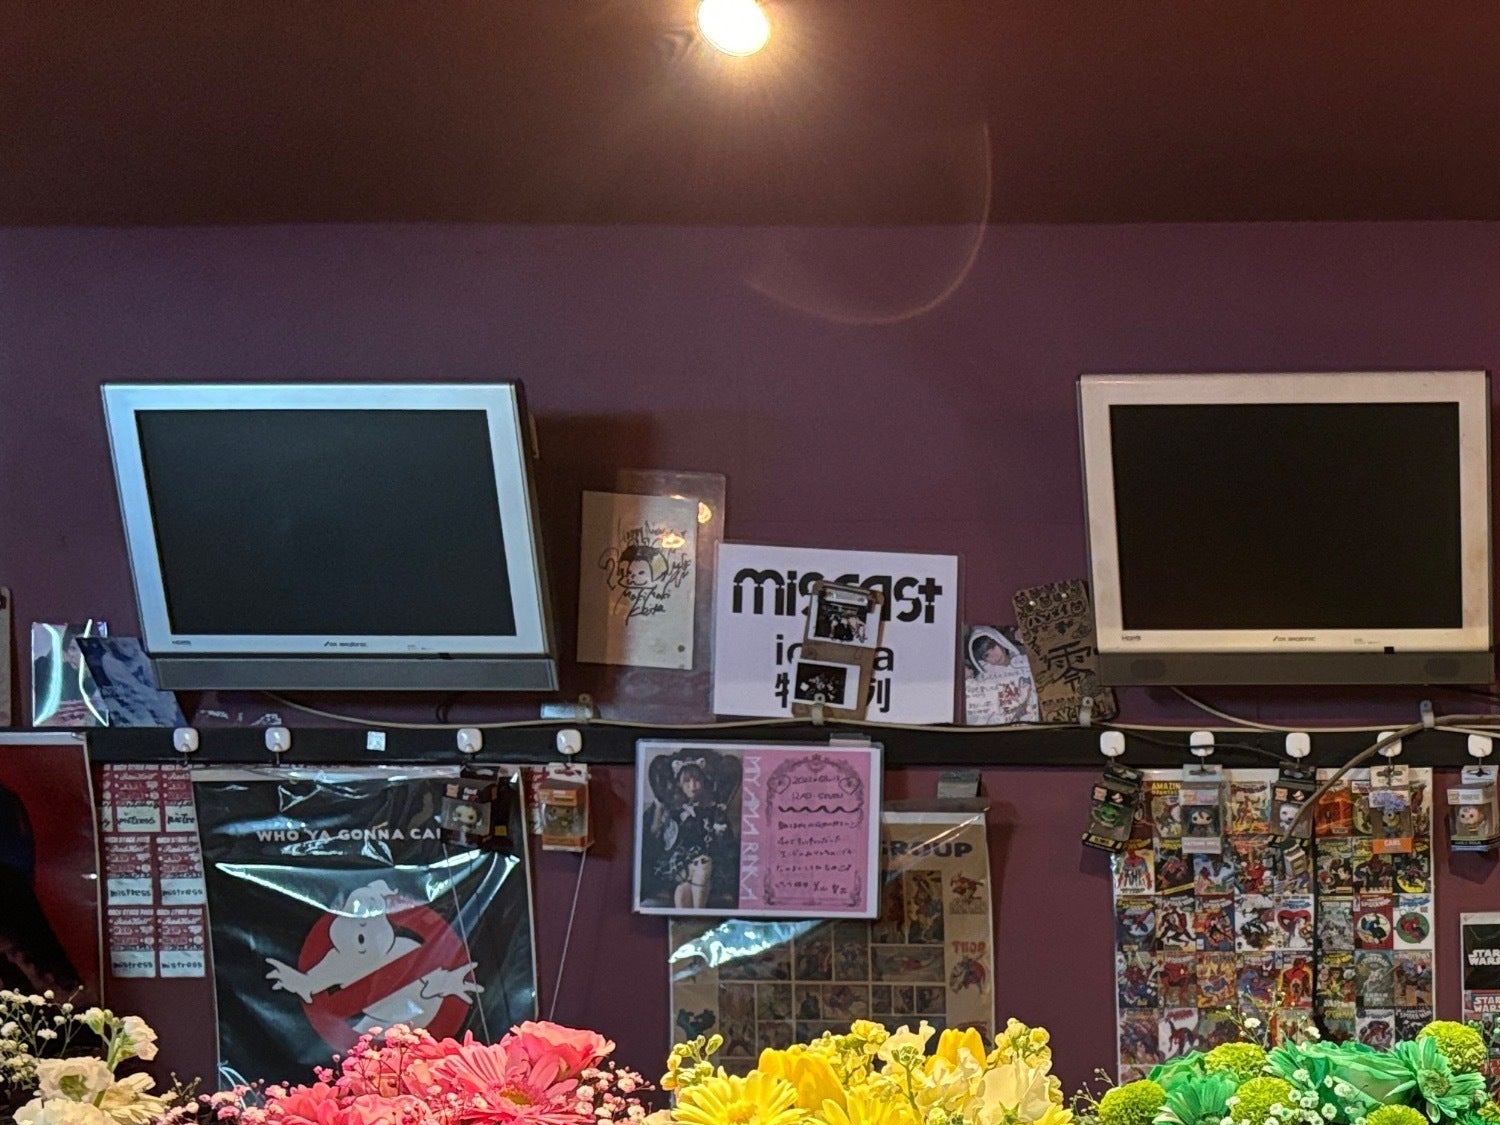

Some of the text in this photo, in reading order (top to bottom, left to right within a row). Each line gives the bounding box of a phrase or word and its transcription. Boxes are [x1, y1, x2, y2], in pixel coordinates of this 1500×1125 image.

[256, 829, 299, 842] WHO
[308, 829, 331, 841] YA
[338, 828, 405, 841] GONNA
